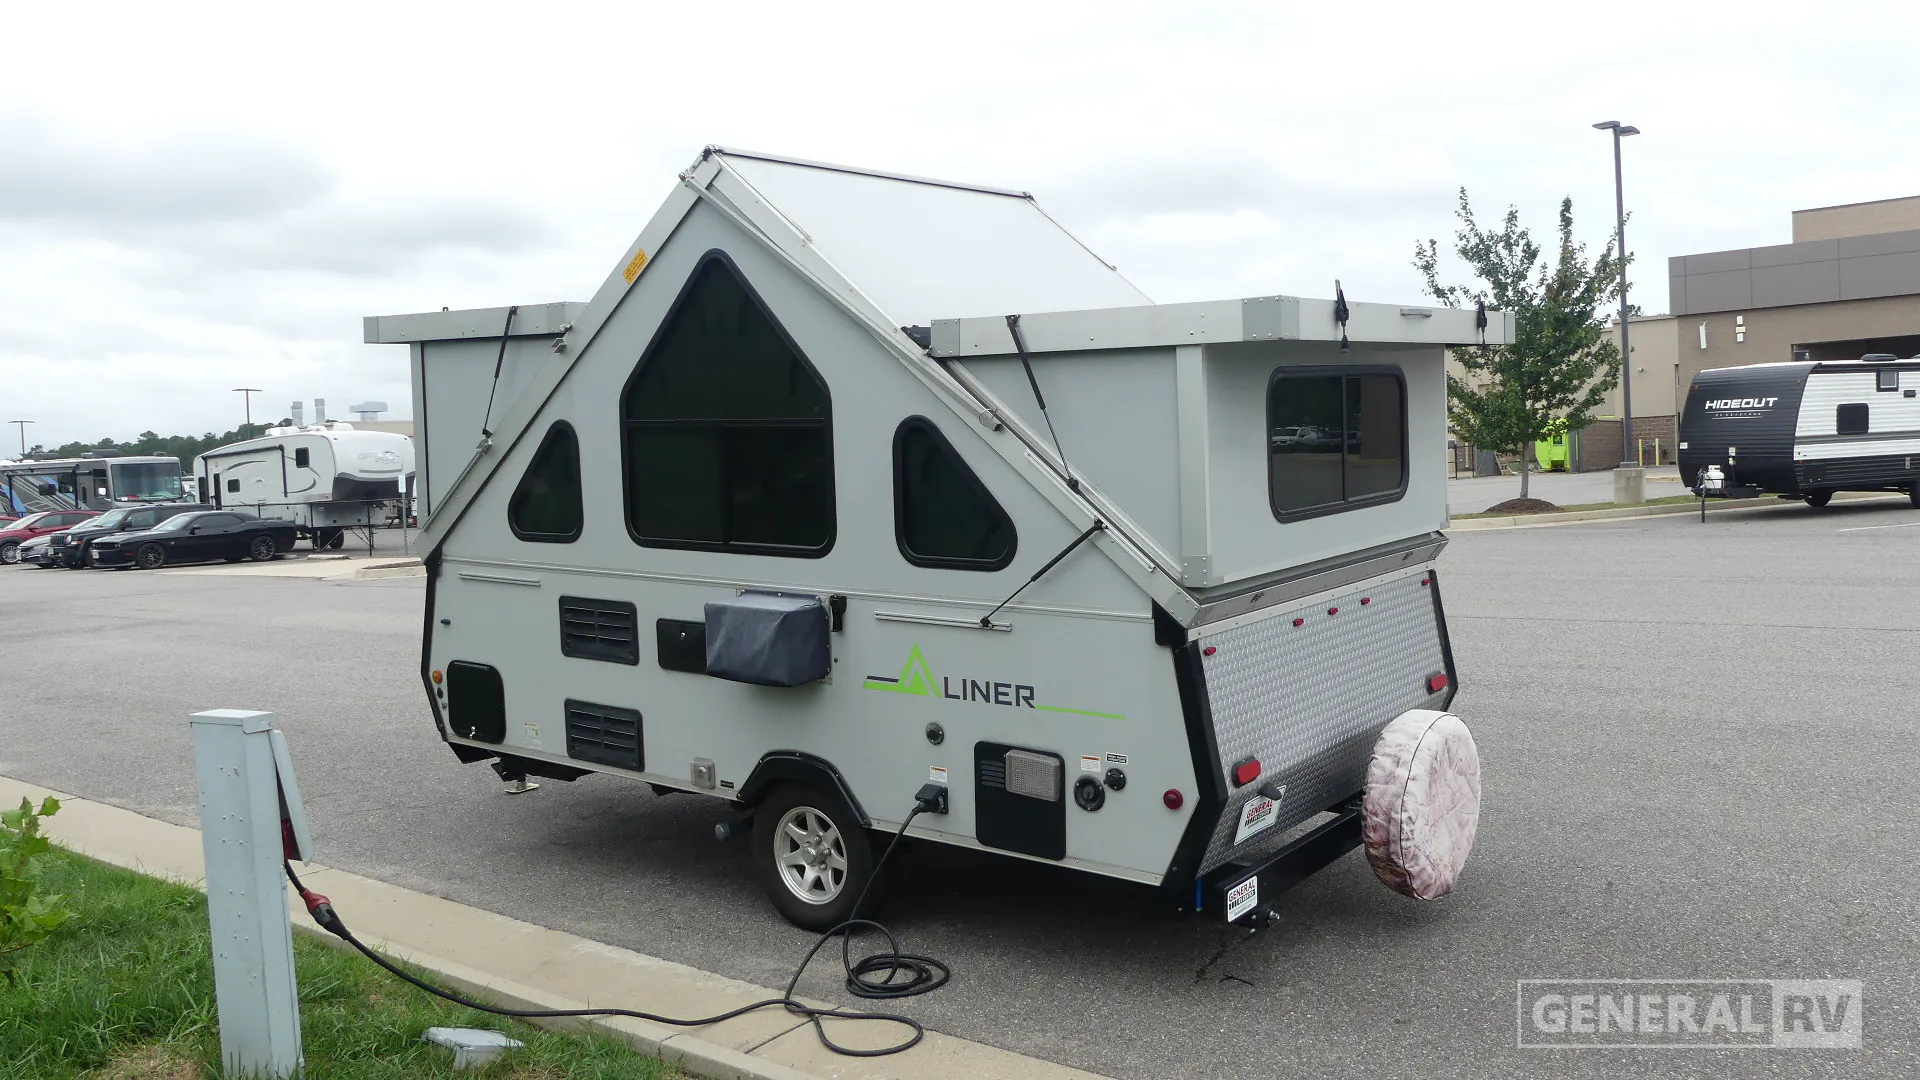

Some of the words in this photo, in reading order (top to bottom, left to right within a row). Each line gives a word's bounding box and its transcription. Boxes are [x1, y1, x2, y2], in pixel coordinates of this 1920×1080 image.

[1704, 397, 1778, 410] HIDEOUT
[1246, 800, 1273, 819] GENERAL
[1228, 879, 1256, 902] GENERAL
